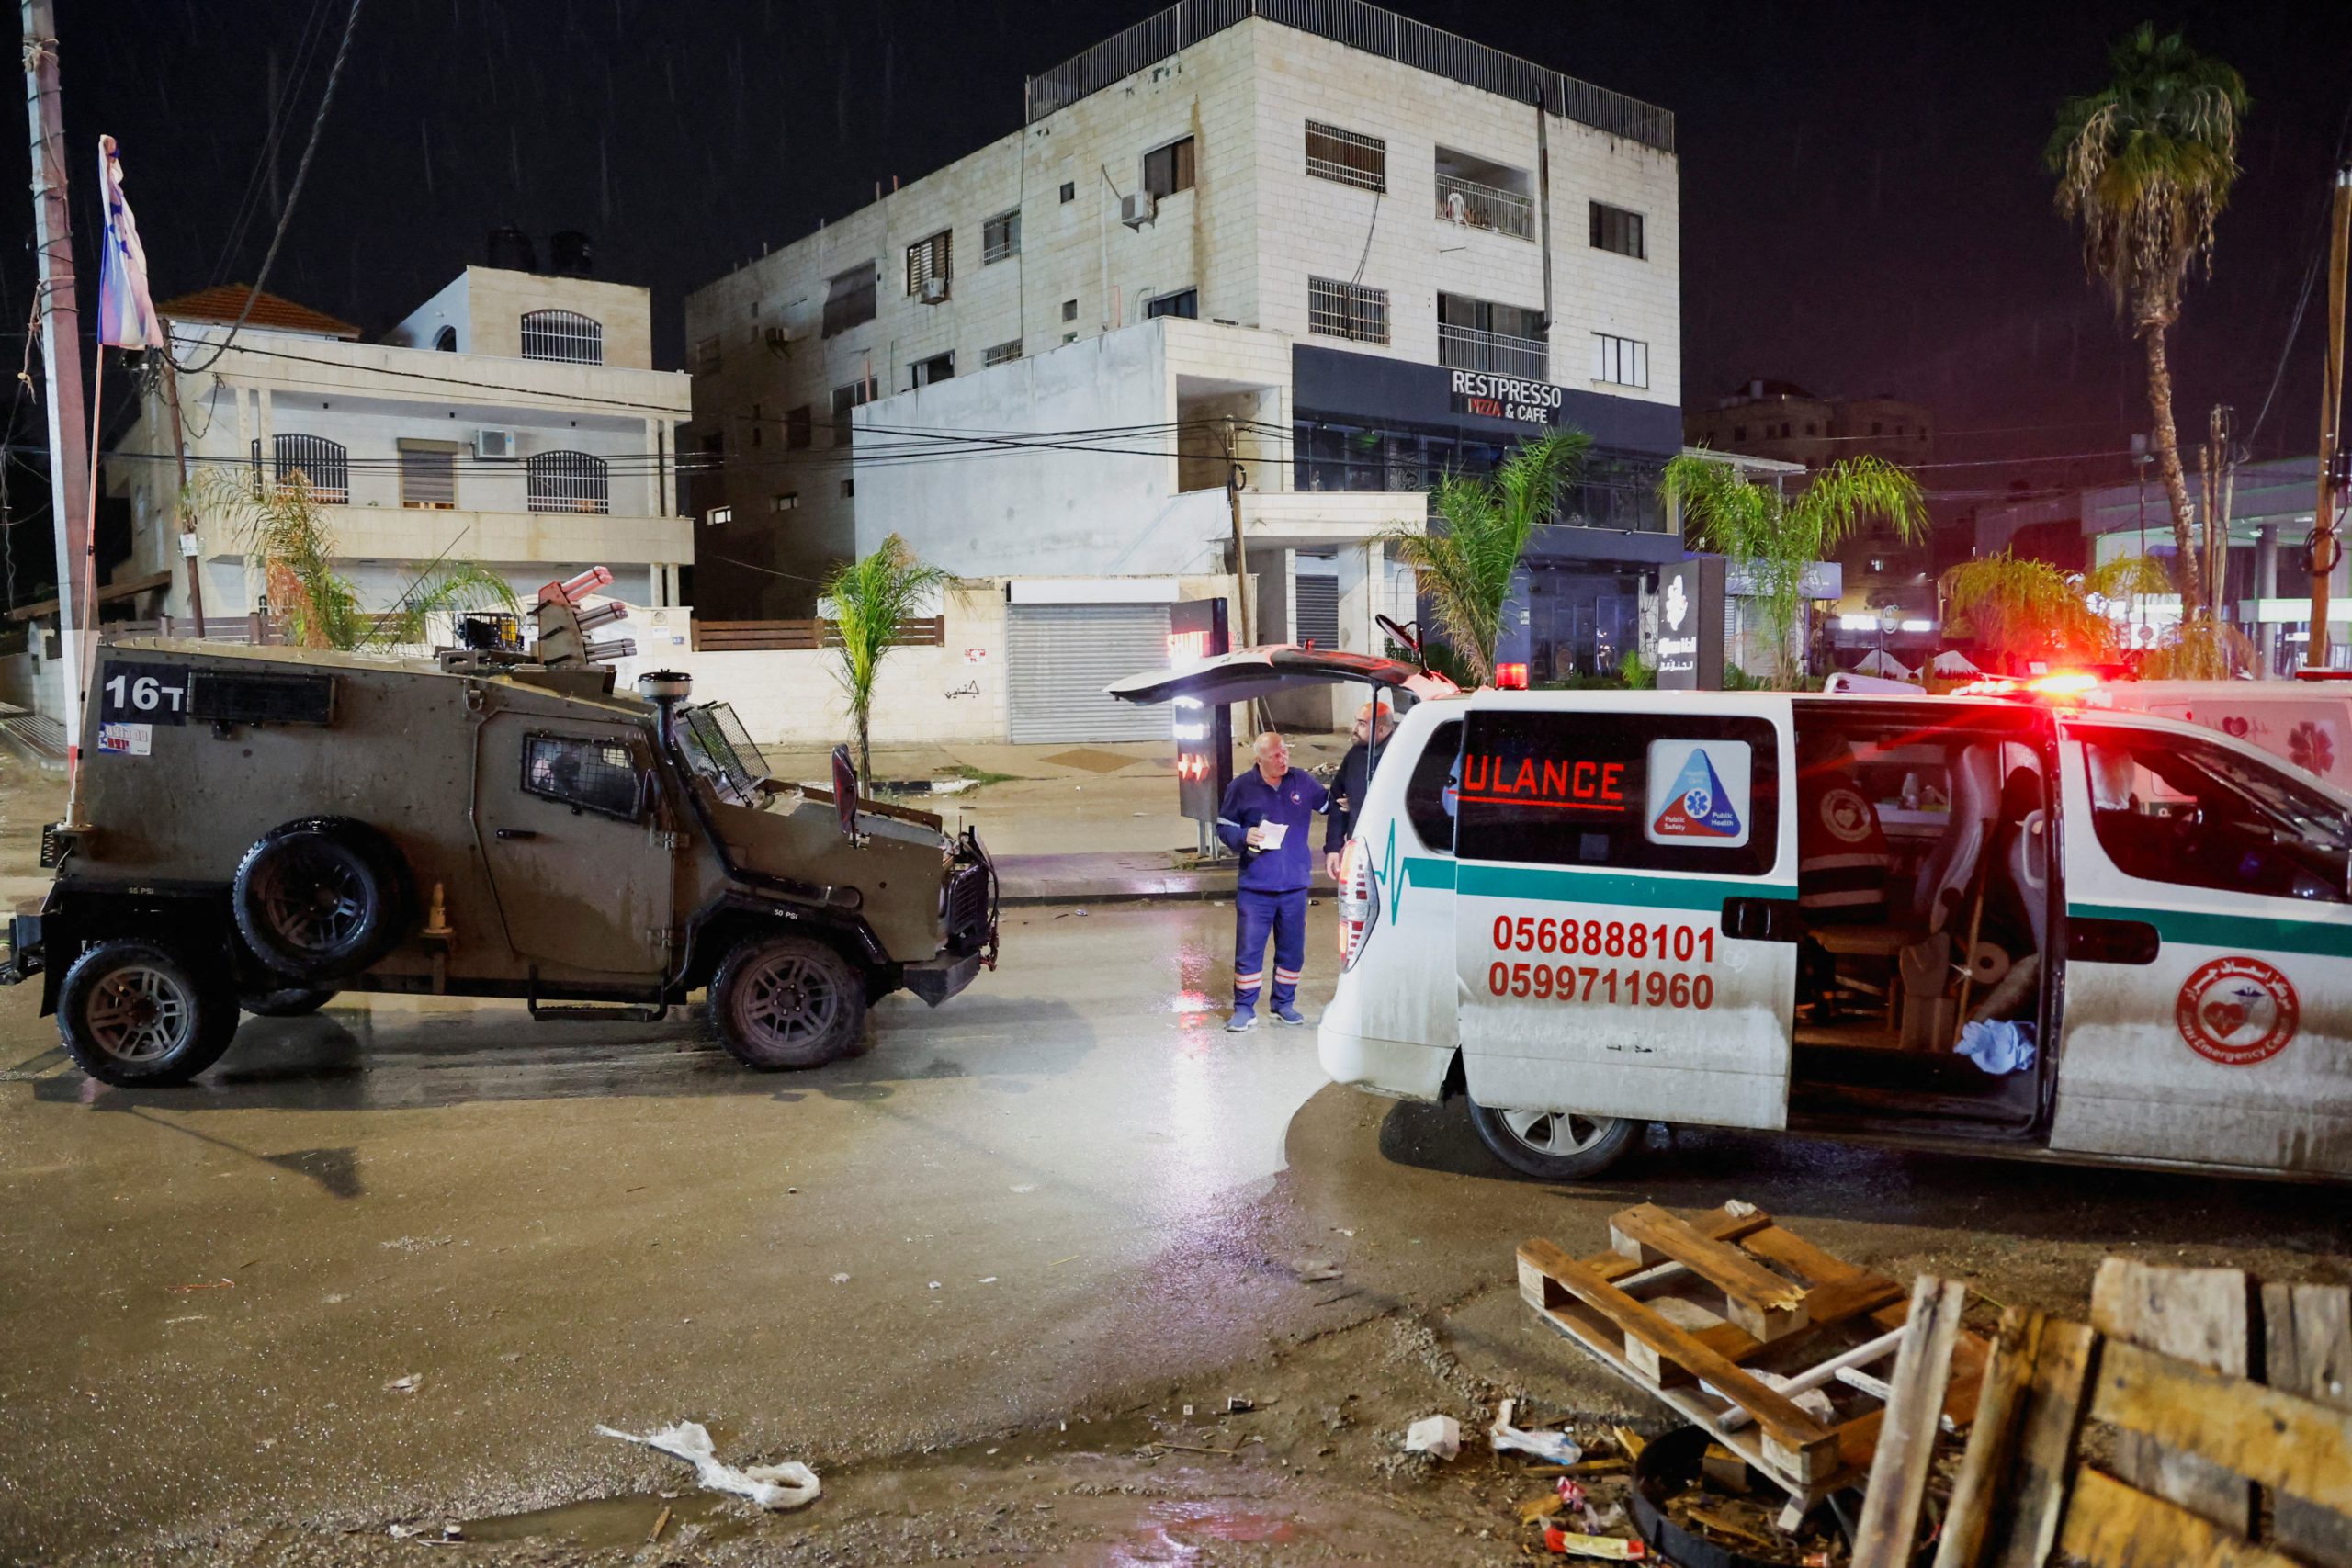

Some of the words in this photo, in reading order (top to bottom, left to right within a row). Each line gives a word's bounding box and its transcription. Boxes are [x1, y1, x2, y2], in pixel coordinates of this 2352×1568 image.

[1452, 370, 1562, 409] RESTPRESSO
[1468, 397, 1501, 418] PIZZA
[1505, 403, 1515, 419] &
[1517, 404, 1548, 424] CAFE
[1664, 823, 1686, 832] Safety
[1713, 811, 1733, 819] Public
[785, 911, 798, 919] PSI
[1493, 915, 1713, 963] 0568888101
[1489, 961, 1714, 1010] 0599711960
[2194, 1038, 2267, 1063] Emergency
